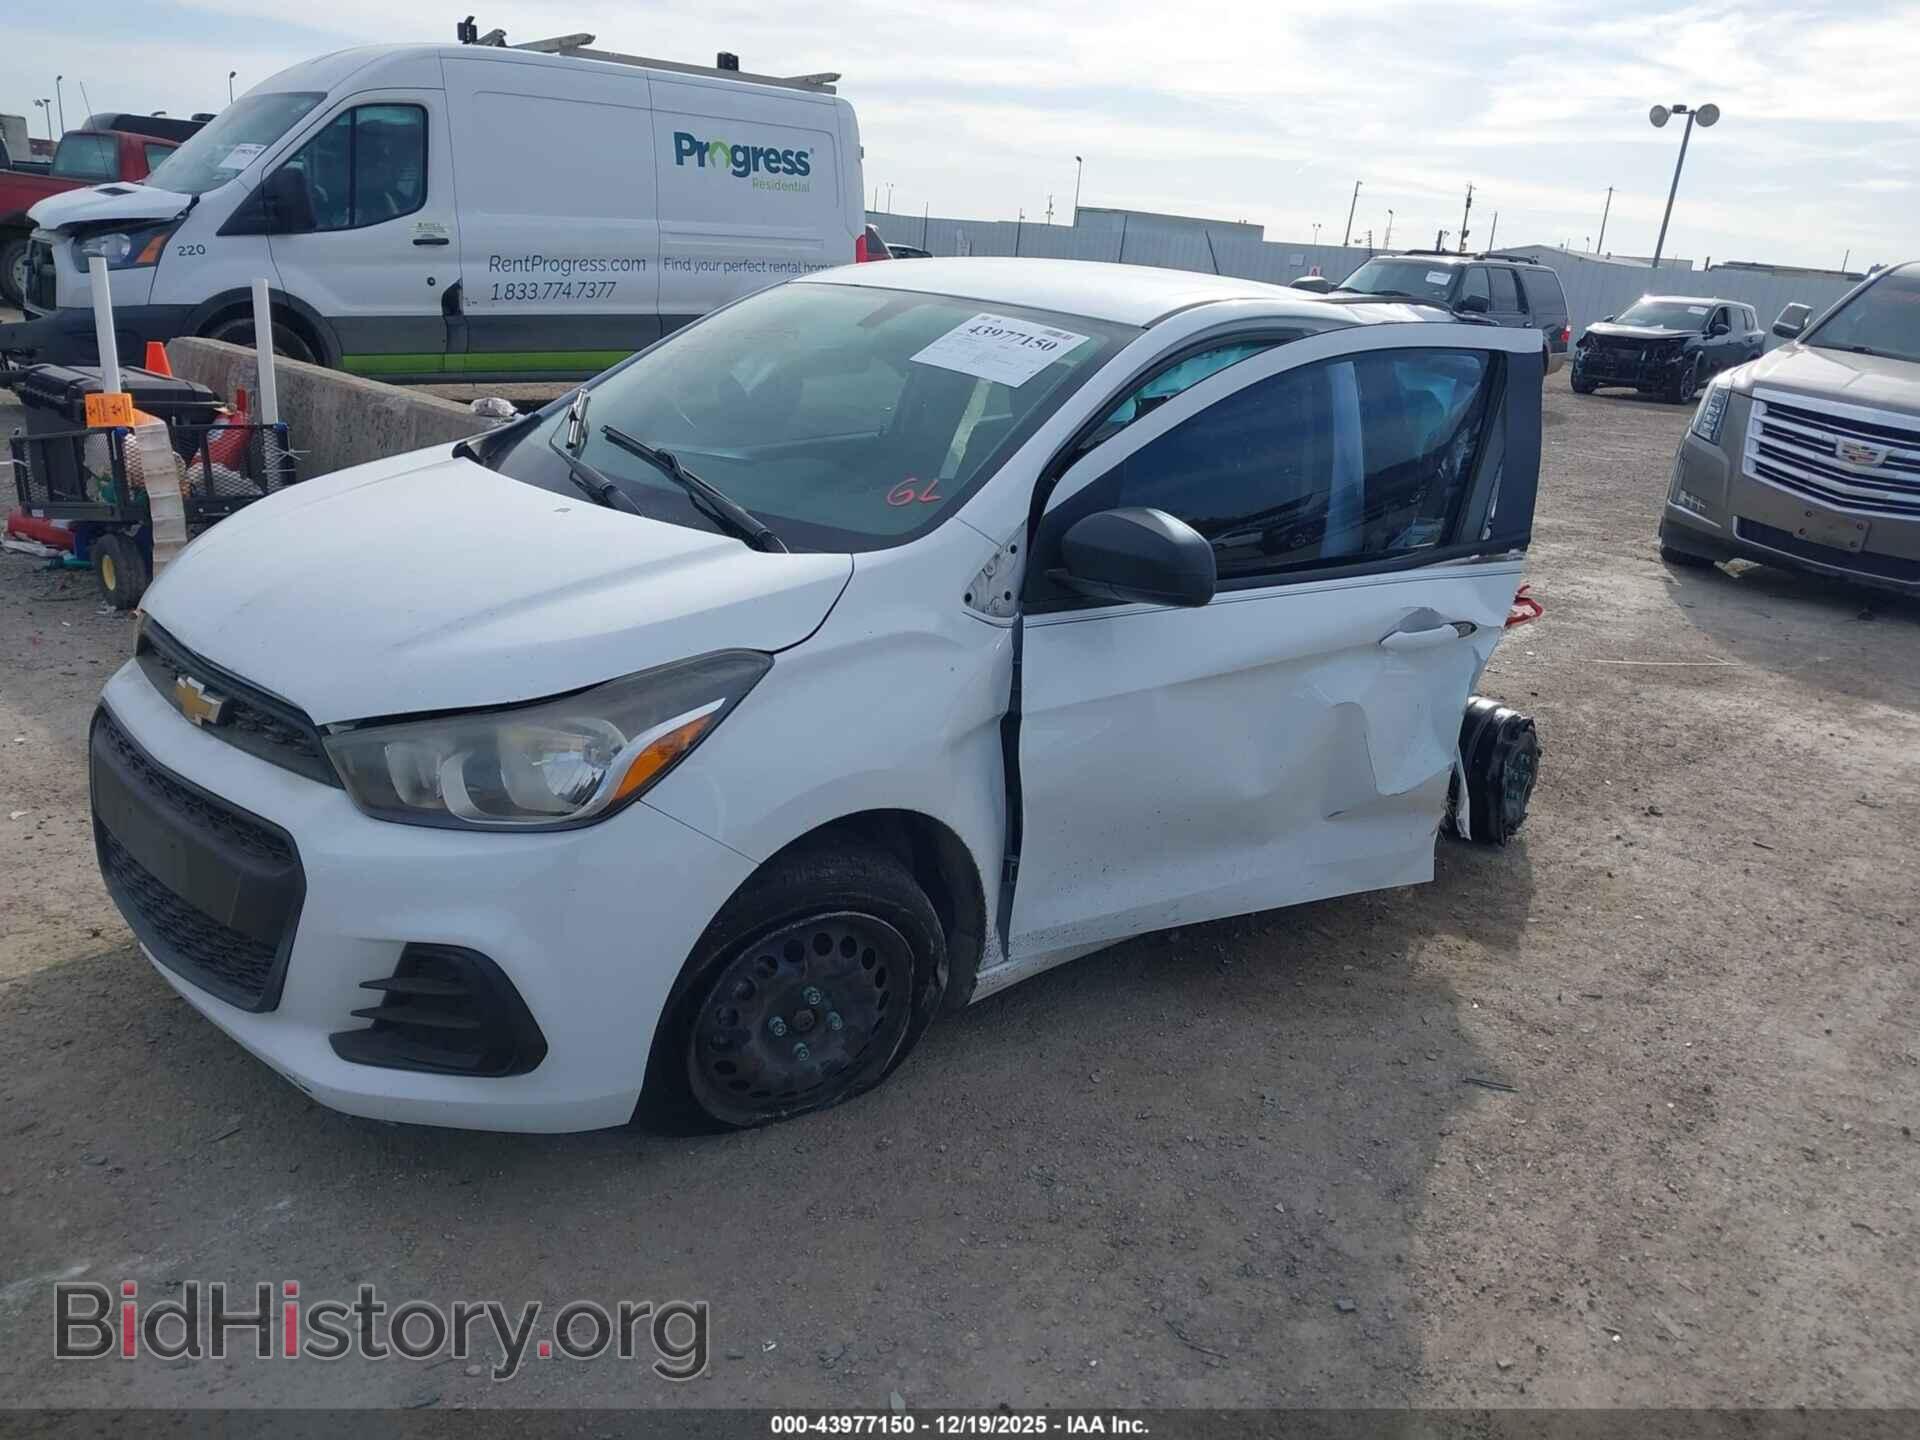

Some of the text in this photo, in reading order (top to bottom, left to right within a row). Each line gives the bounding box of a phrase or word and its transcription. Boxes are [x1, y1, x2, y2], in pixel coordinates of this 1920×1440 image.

[674, 132, 811, 178] Progress
[752, 178, 811, 192] Residential
[177, 244, 206, 256] 220
[489, 255, 646, 276] RentProgress.com
[664, 257, 691, 272] Find
[694, 260, 720, 274] your
[723, 259, 766, 274] perfect
[769, 262, 800, 273] rental
[490, 281, 616, 301] 1.833.774.7377
[968, 325, 1058, 351] 43977150
